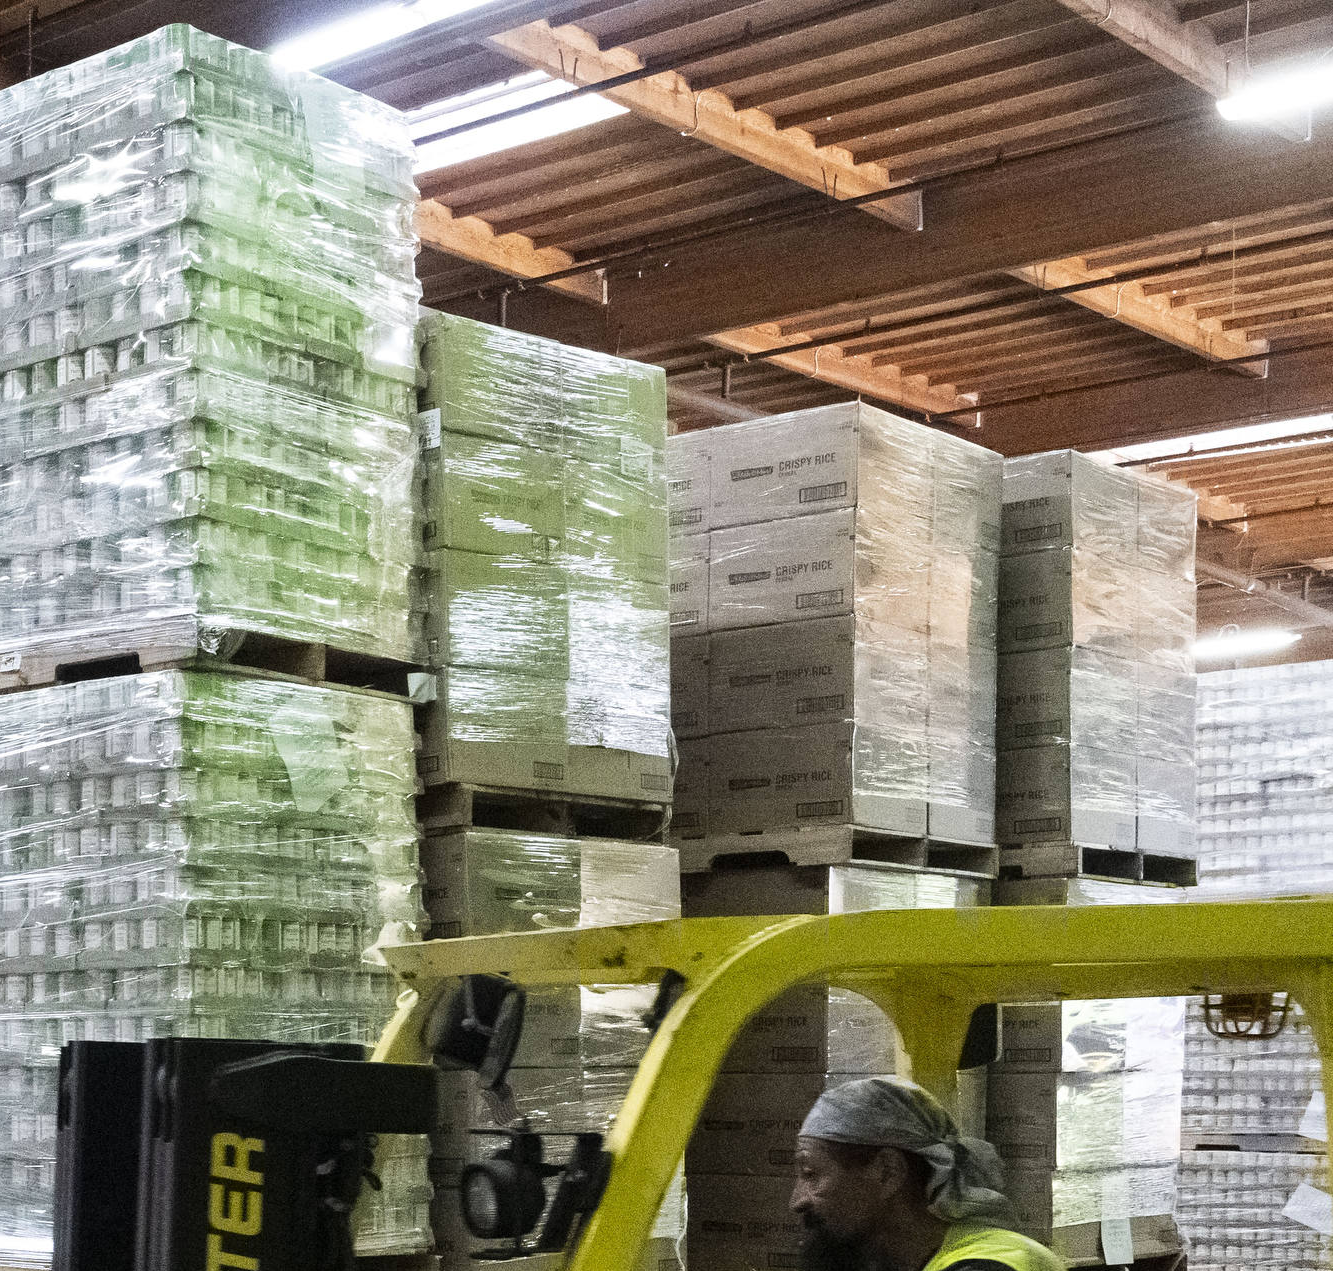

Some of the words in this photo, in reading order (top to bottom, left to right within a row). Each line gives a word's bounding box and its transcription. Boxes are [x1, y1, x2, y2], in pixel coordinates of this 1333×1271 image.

[778, 457, 812, 471] CRISPY
[815, 452, 836, 464] RICE
[775, 563, 808, 576] CRISPY
[811, 560, 833, 571] RICE
[776, 668, 808, 679] CRISPY
[812, 664, 833, 675] RICE
[811, 769, 832, 781] RICE
